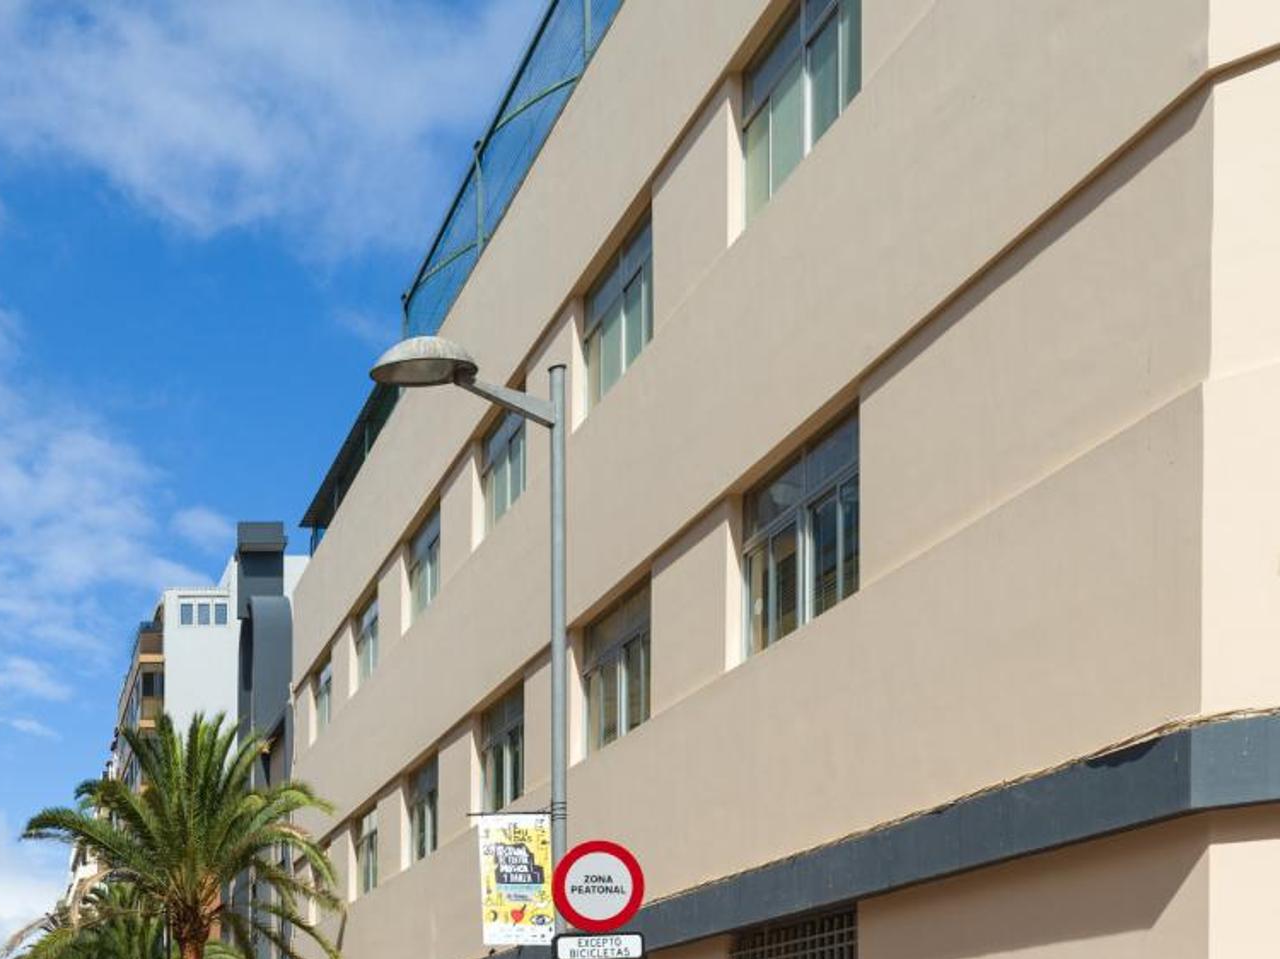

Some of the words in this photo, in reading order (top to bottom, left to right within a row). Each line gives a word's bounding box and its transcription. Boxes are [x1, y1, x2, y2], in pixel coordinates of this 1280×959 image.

[583, 874, 614, 883] ZONA
[571, 885, 626, 895] PEATONAL
[578, 937, 622, 948] EXCEPTO
[569, 947, 630, 958] BICICLETAS
